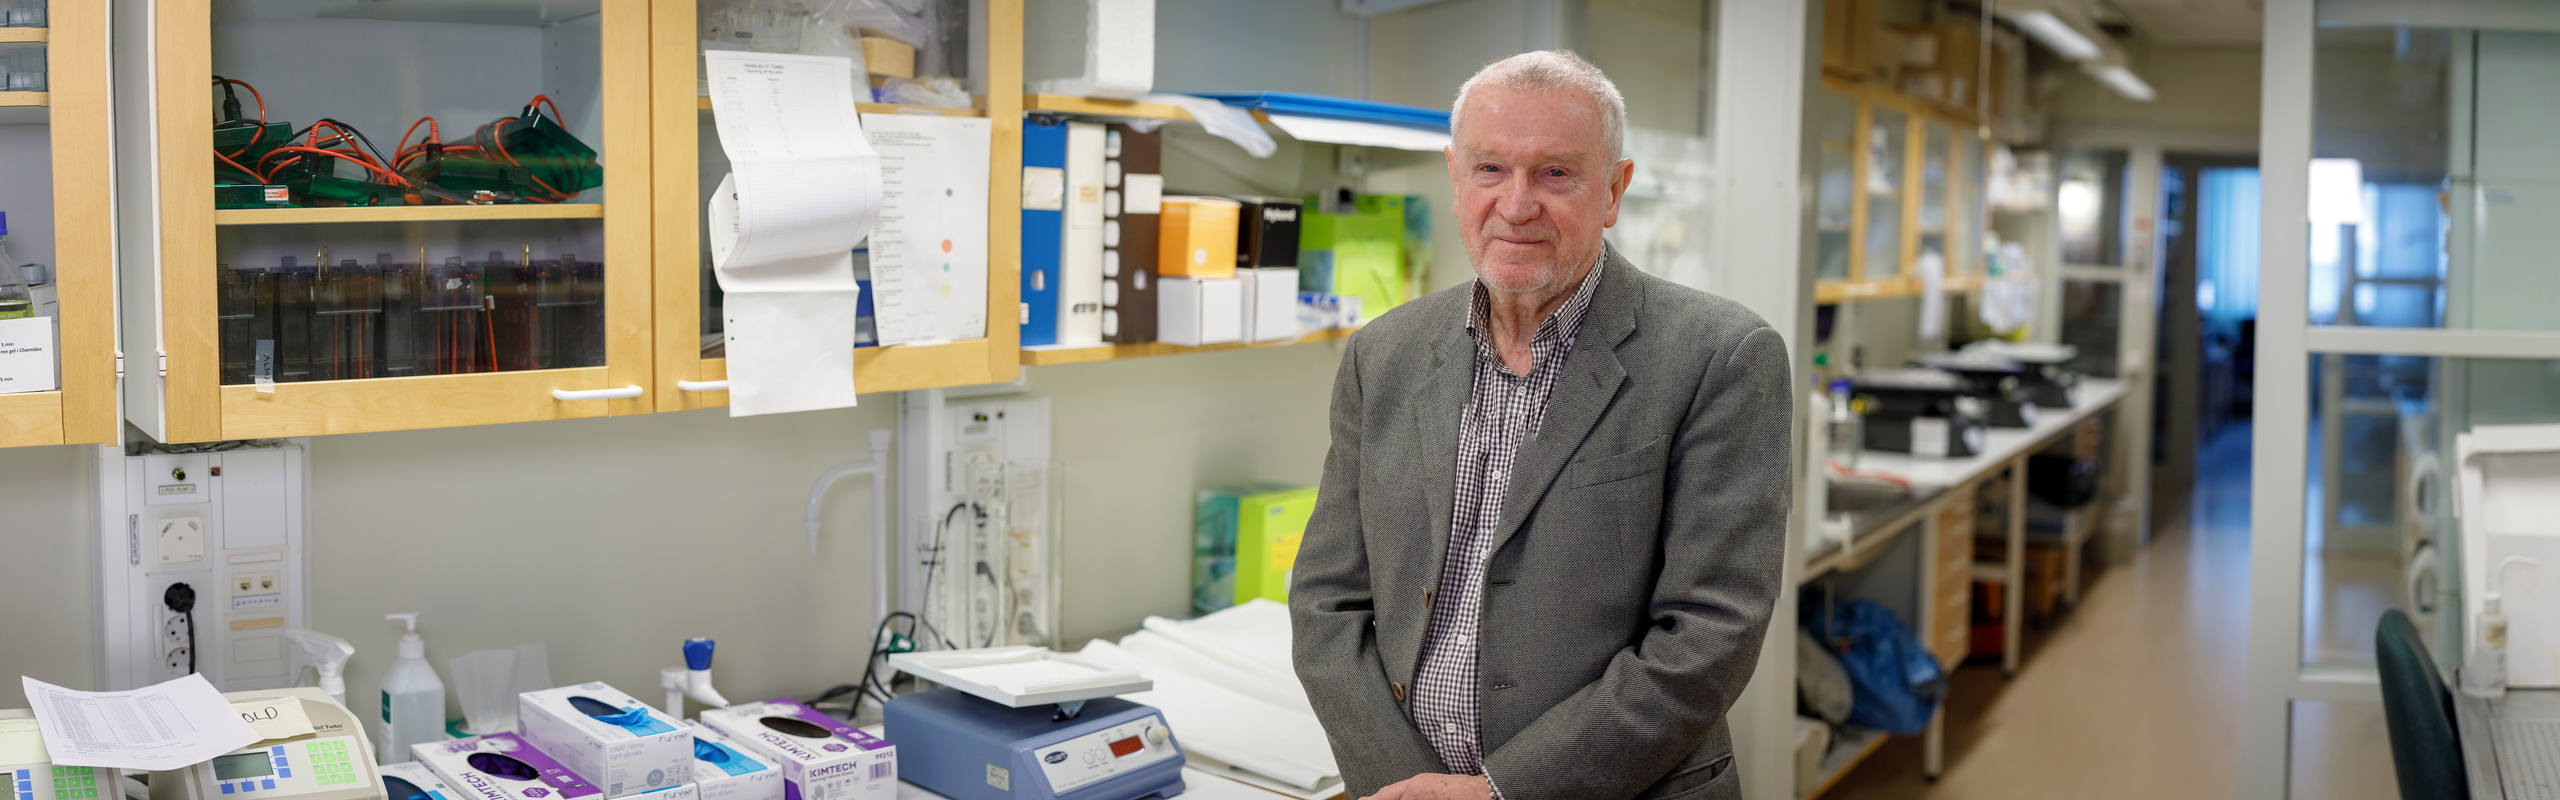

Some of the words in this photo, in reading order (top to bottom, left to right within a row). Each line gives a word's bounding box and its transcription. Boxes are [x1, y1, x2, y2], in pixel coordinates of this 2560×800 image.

[1264, 207, 1297, 223] Hybond
[627, 742, 645, 750] Nitrile
[609, 753, 623, 761] light
[623, 750, 643, 759] gloves
[875, 751, 894, 760] 99212
[809, 761, 857, 778] KIMTECH
[650, 772, 660, 781] M
[459, 771, 507, 800] IMTECH
[720, 781, 737, 789] Nitrile
[704, 792, 716, 800] light
[717, 789, 735, 798] gloves
